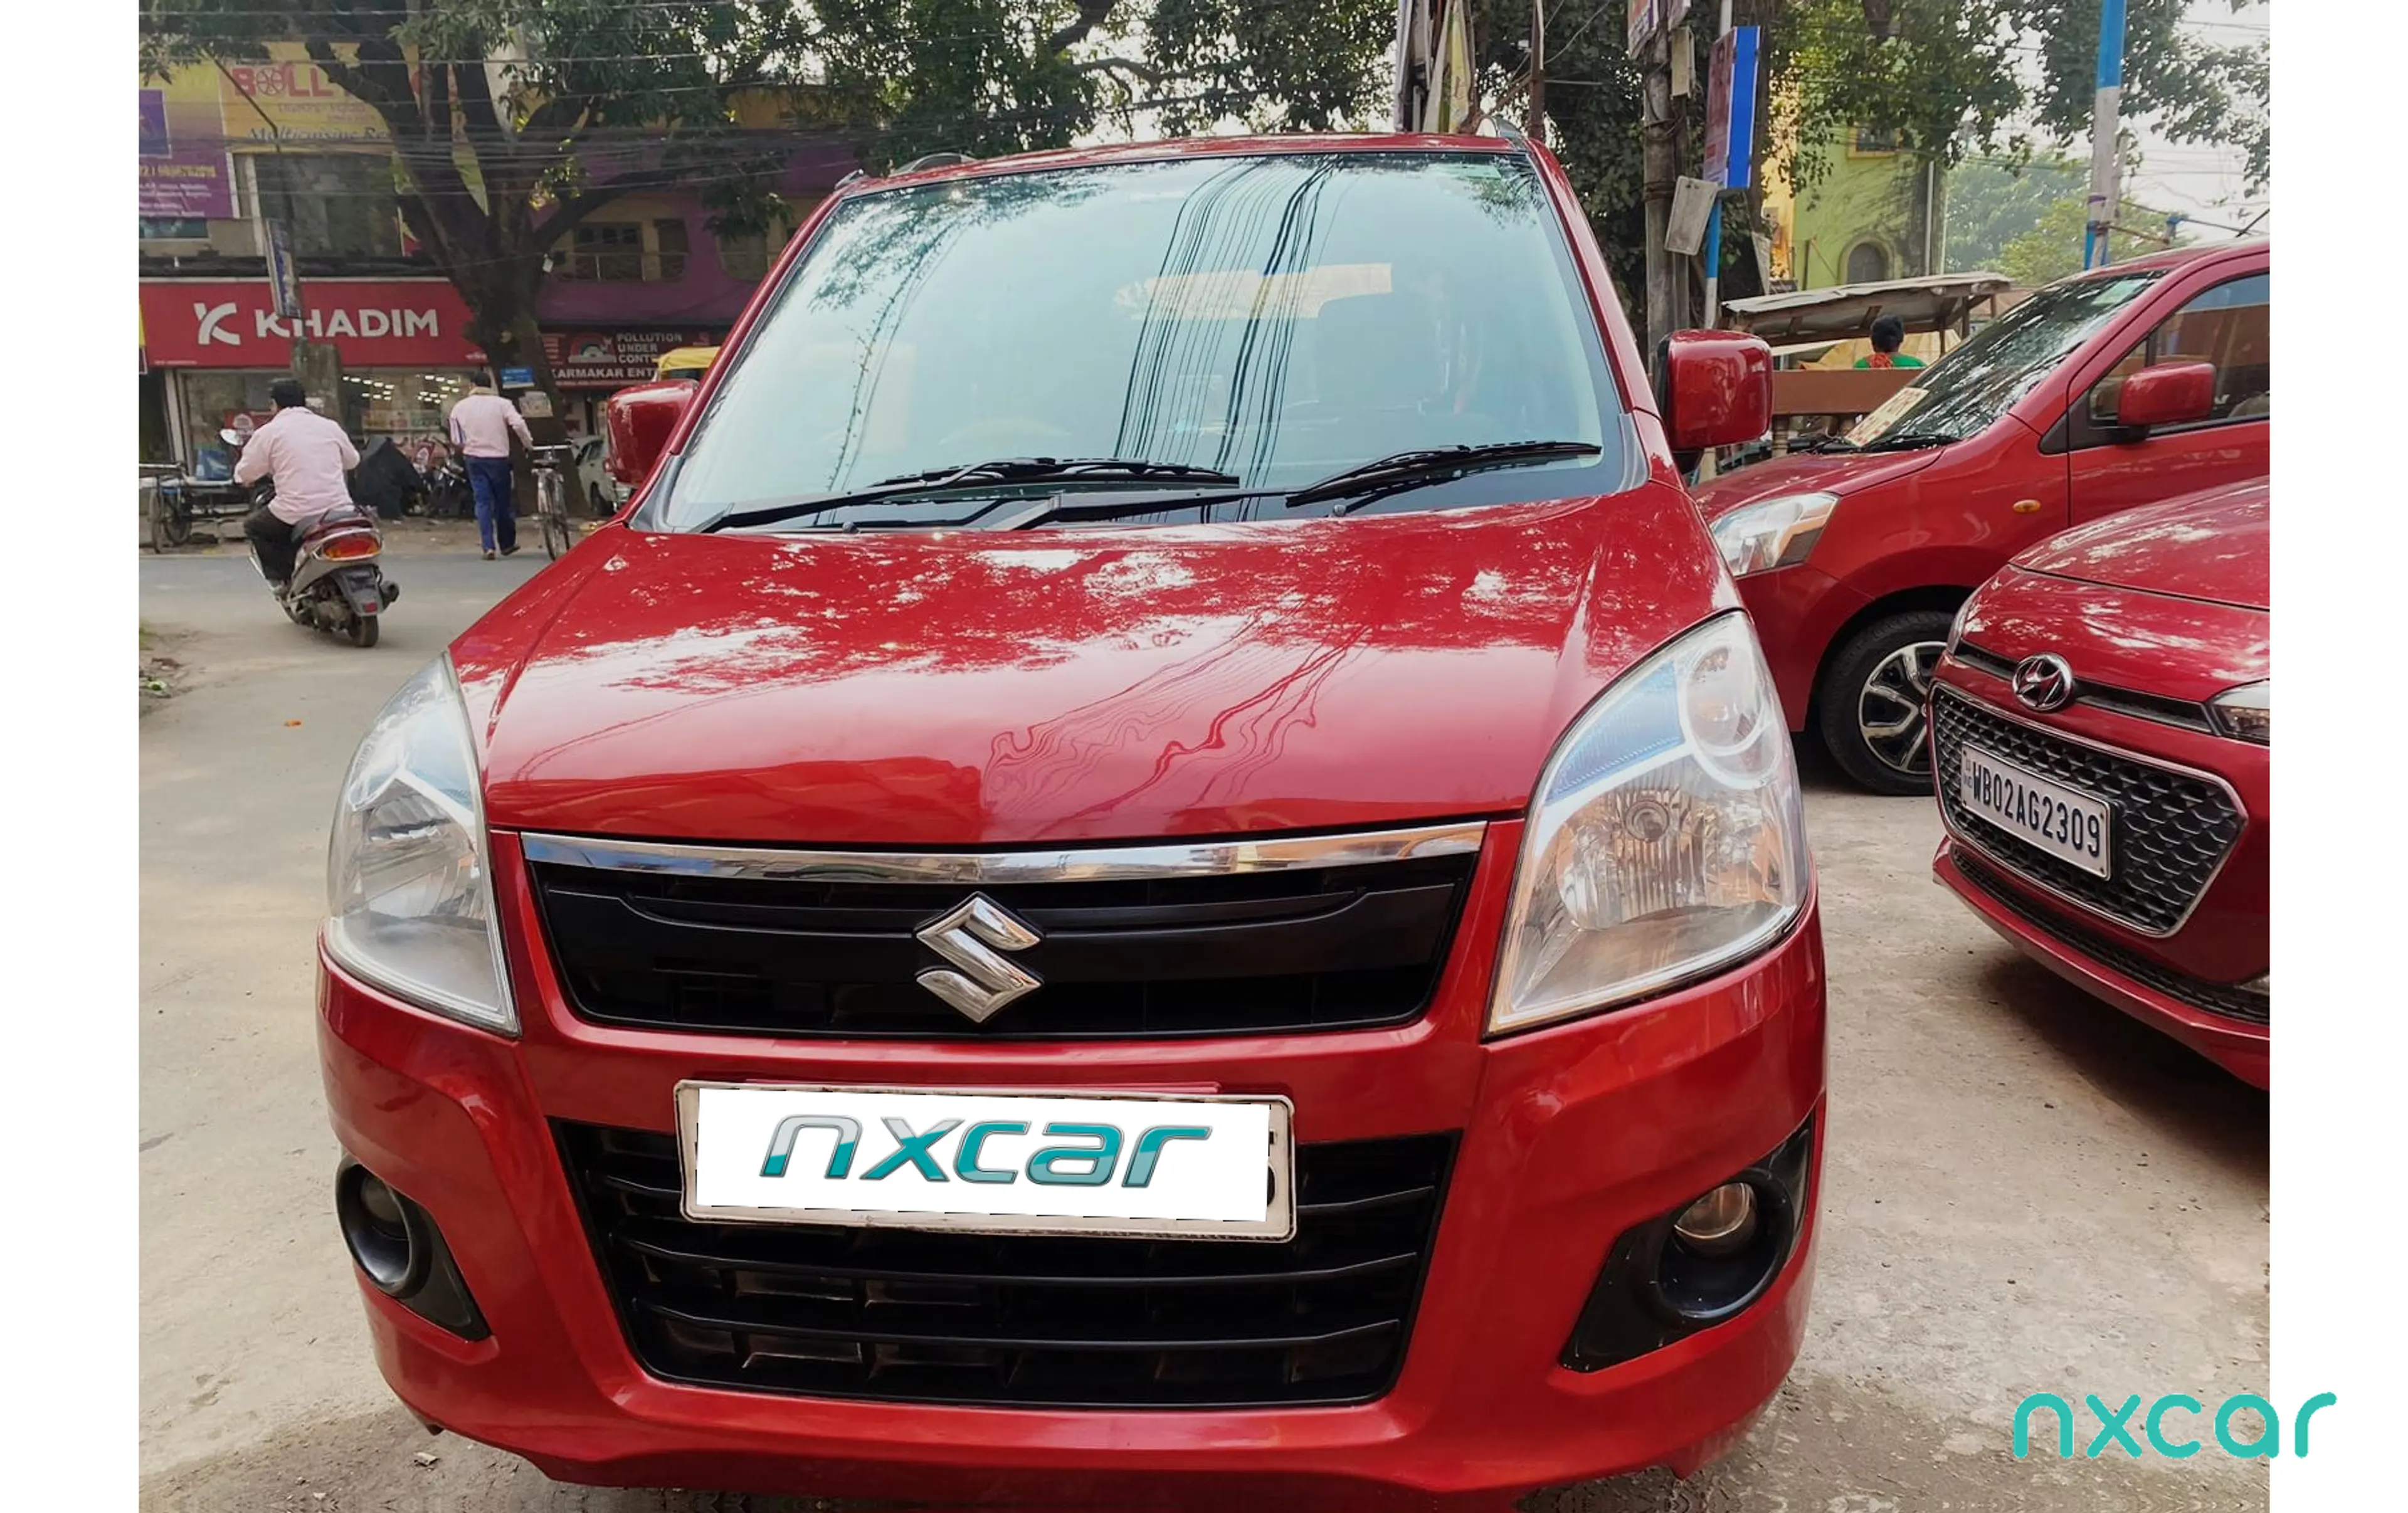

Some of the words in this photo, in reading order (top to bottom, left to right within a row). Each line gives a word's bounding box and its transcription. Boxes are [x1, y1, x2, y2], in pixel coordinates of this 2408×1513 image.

[233, 63, 349, 97] BOLL
[256, 309, 438, 337] KHADIM
[616, 333, 682, 342] POLLUTION
[617, 344, 658, 353] UNDER
[618, 354, 653, 364] CONT
[627, 367, 656, 377] ENT
[1973, 762, 2100, 858] WB02AG2309
